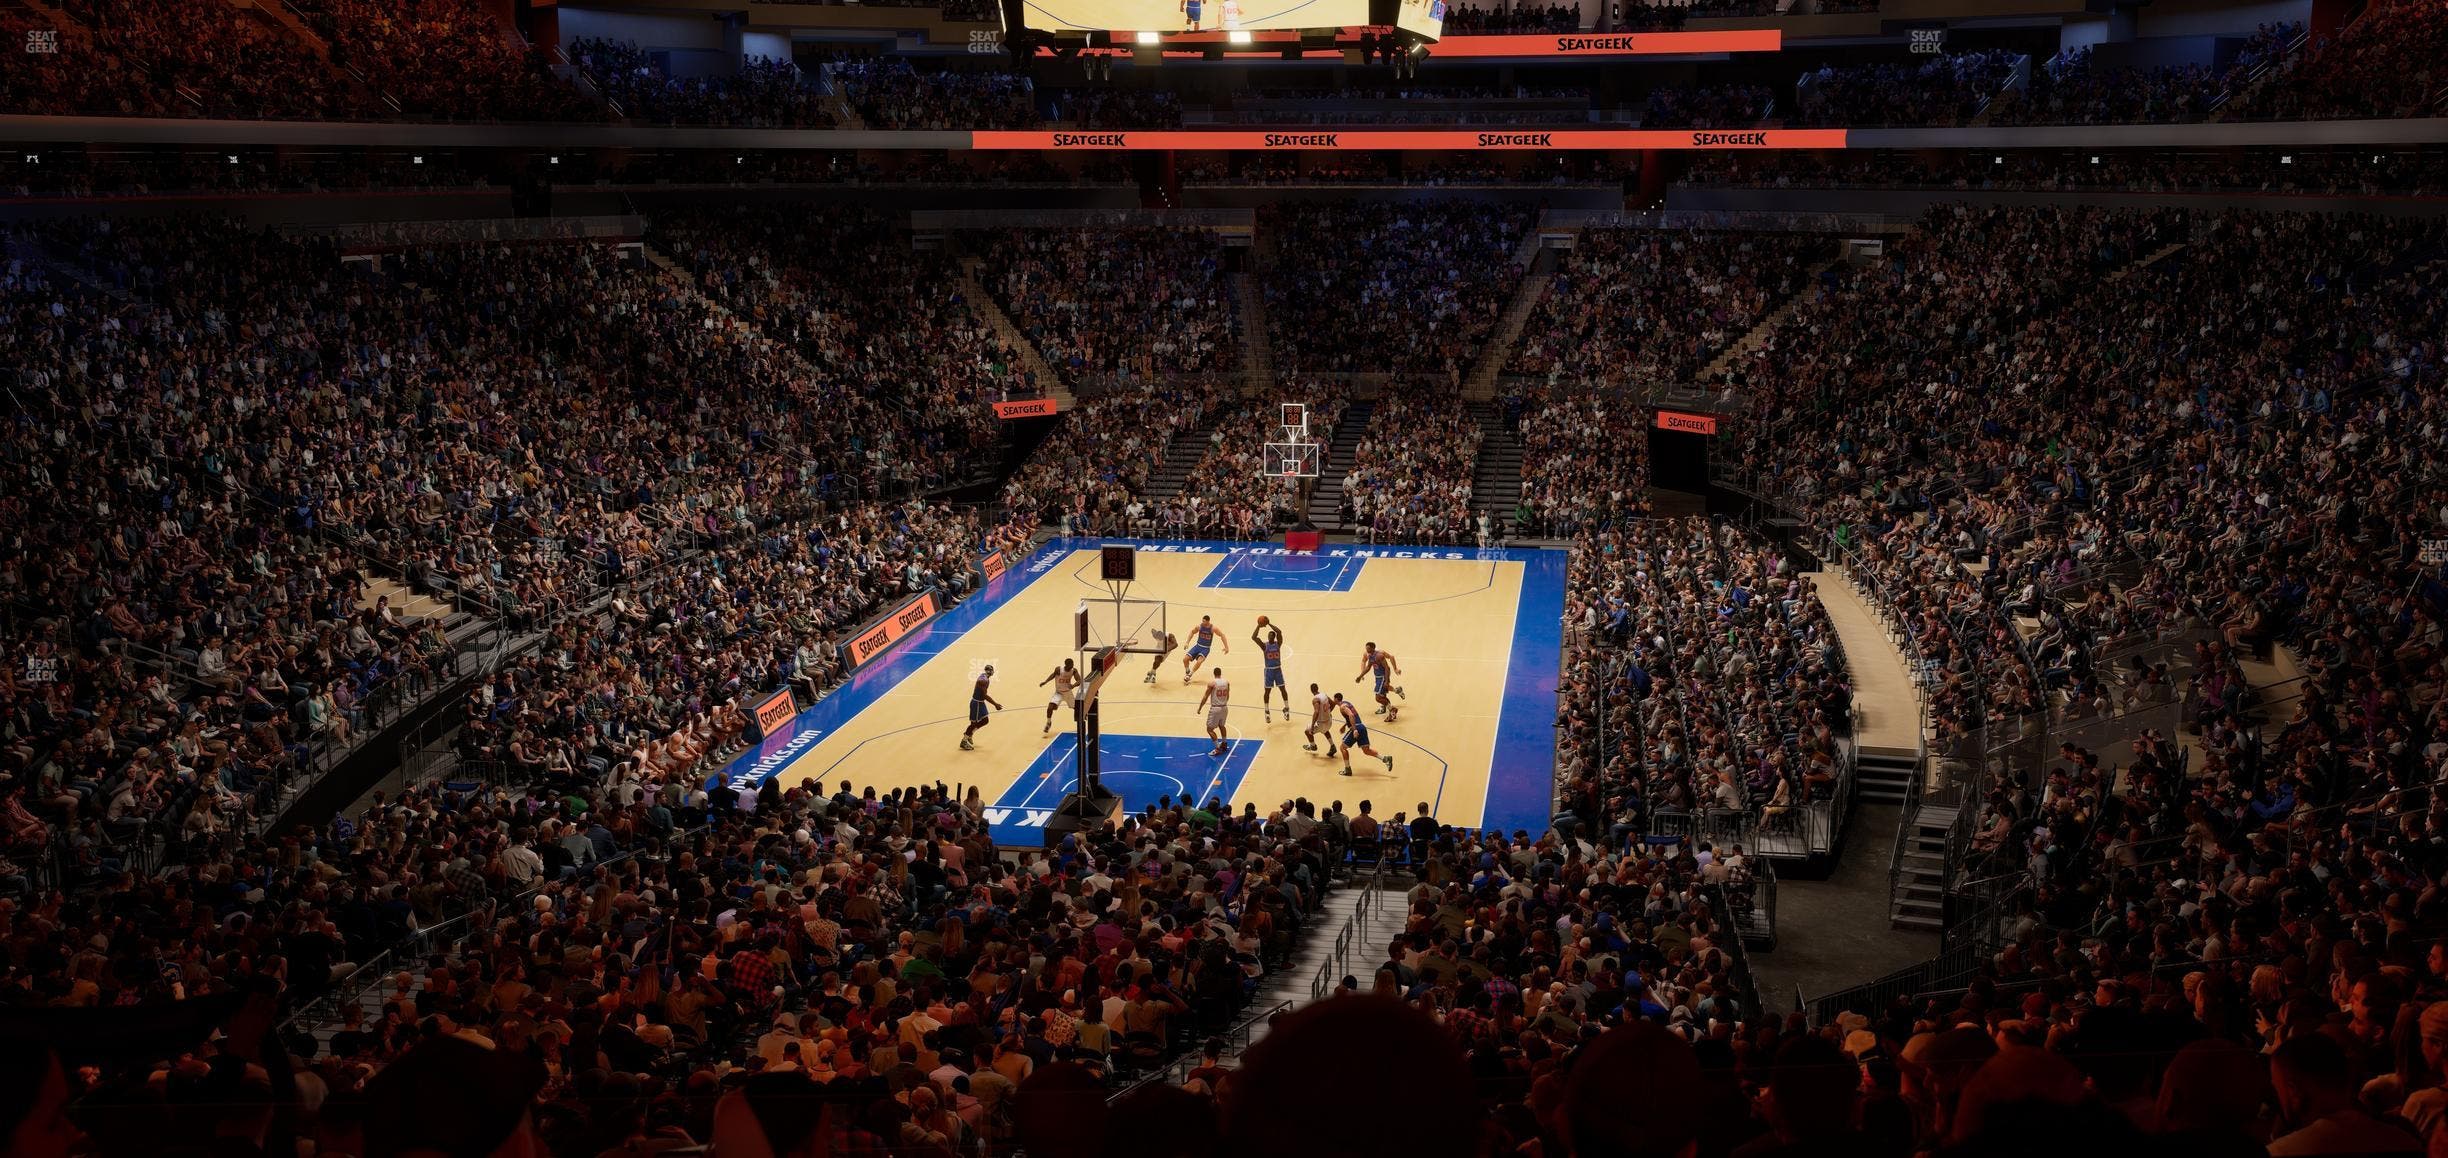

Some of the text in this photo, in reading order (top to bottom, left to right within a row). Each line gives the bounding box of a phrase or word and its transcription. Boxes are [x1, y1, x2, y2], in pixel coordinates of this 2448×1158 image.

[1558, 36, 1633, 51] SEATGEEK
[1054, 134, 1126, 147] SEATGEEK
[1265, 134, 1338, 147] SEATGEEK
[1479, 134, 1552, 147] SEATGEEK
[1693, 133, 1767, 146] SEATGEEK
[1003, 403, 1046, 416] SEATGEEK
[1668, 417, 1706, 431] SEATGEEK
[1228, 547, 1313, 556] YORK
[1330, 550, 1464, 559] KNICKS
[859, 602, 928, 659] SEATGEEK SEATGEEK
[760, 696, 794, 731] SEATGEEK
